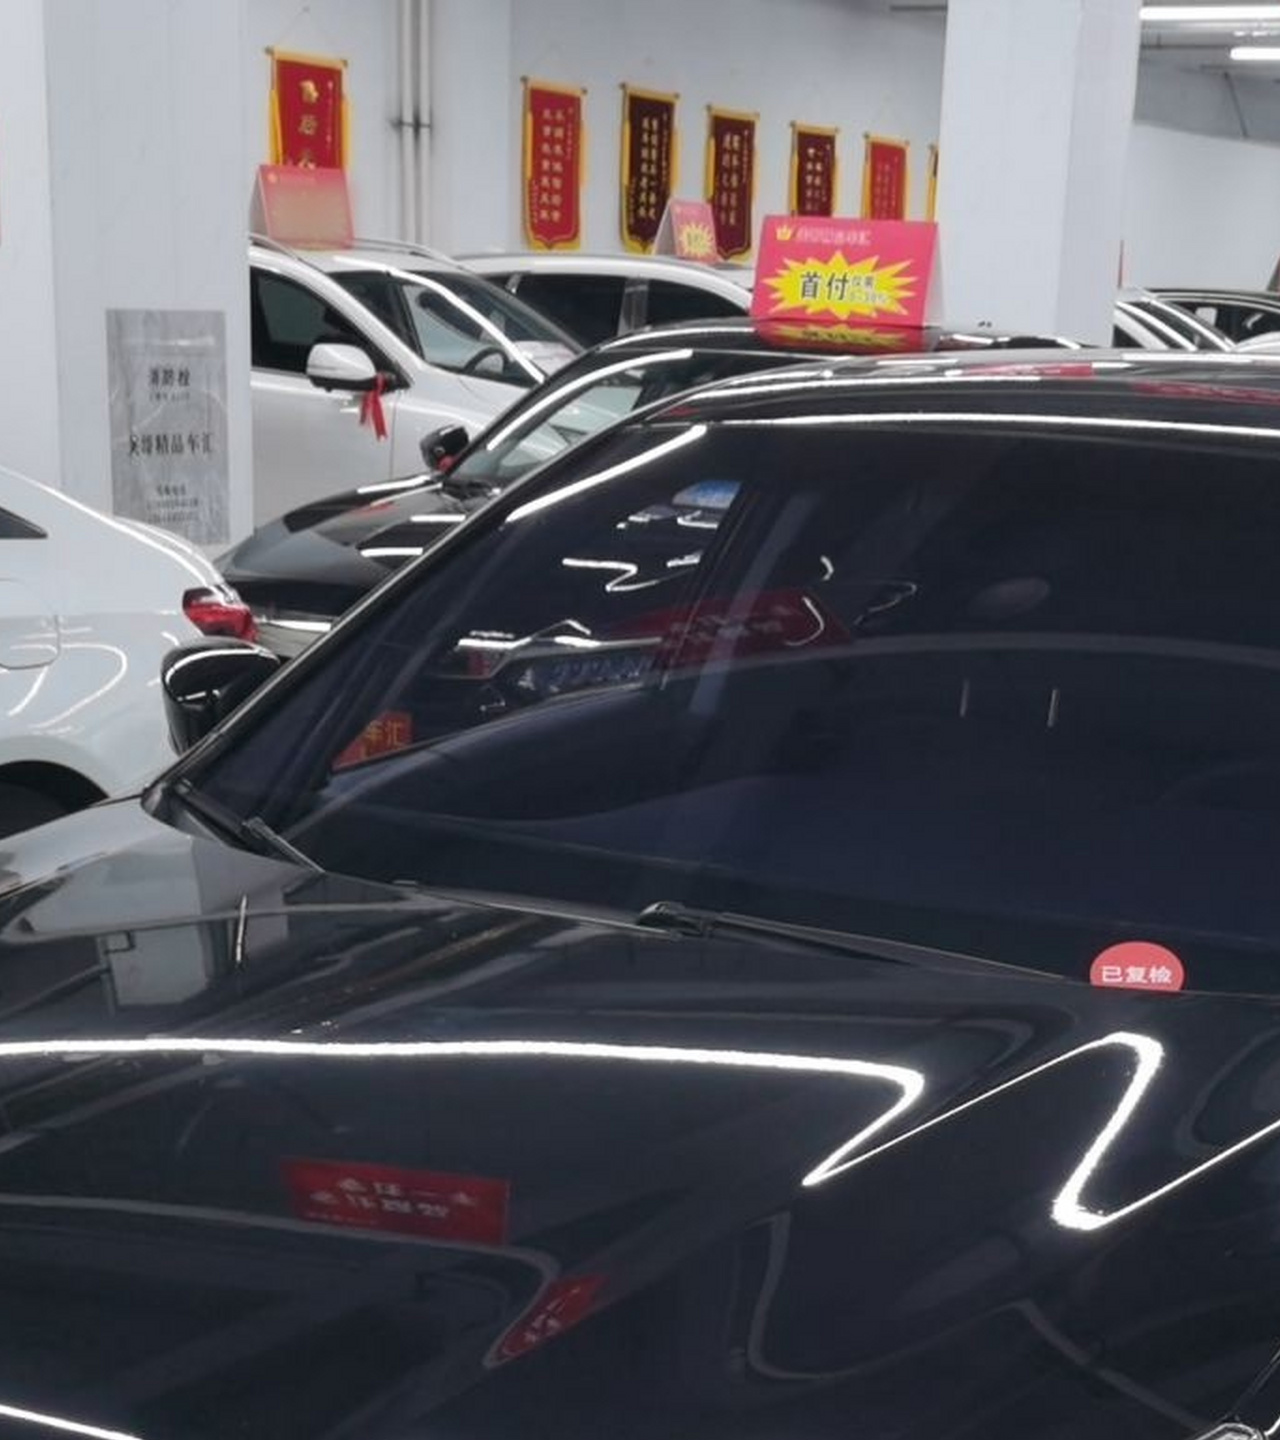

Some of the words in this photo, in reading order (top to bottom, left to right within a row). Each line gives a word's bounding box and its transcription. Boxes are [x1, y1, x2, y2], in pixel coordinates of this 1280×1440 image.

[801, 272, 849, 301] 首付
[1101, 965, 1173, 985] 已复检
